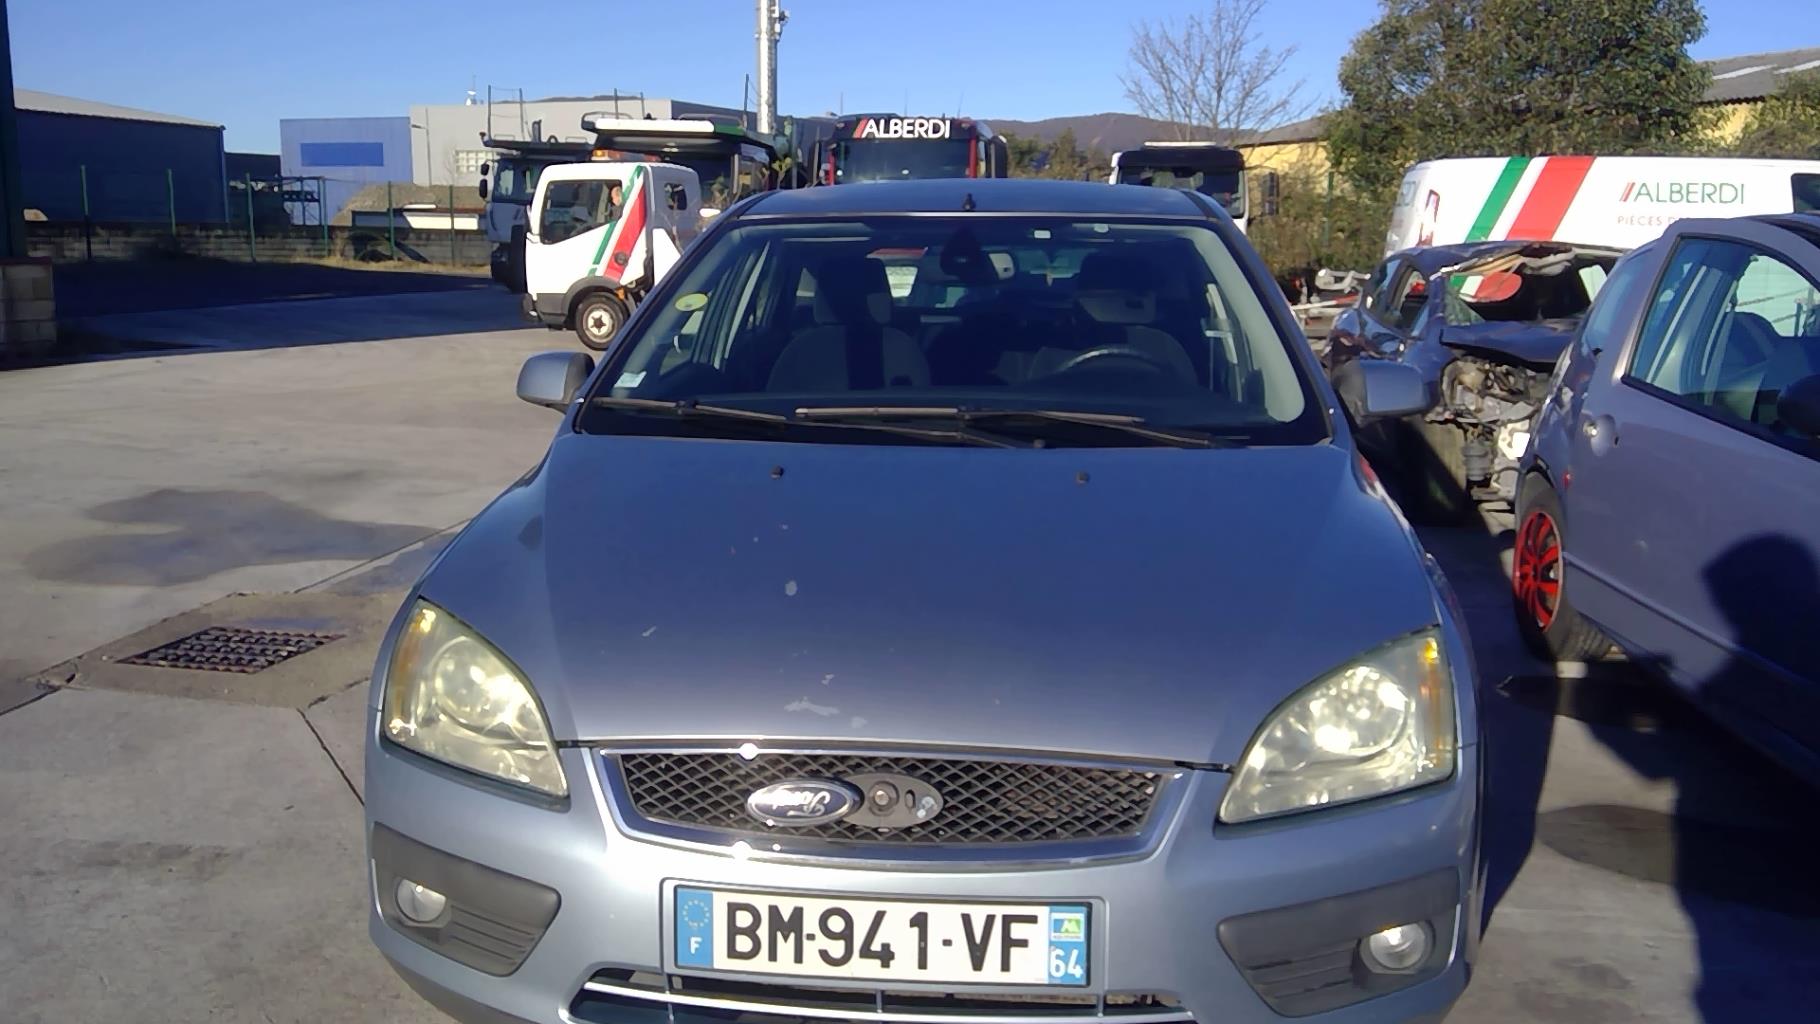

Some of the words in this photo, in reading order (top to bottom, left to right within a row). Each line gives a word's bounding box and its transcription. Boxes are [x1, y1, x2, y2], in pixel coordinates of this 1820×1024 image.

[861, 119, 951, 138] ALBERDI
[1633, 182, 1744, 204] ALBERDI
[690, 936, 701, 955] F
[726, 901, 1038, 972] BM-941-VF
[1049, 948, 1083, 979] 64
